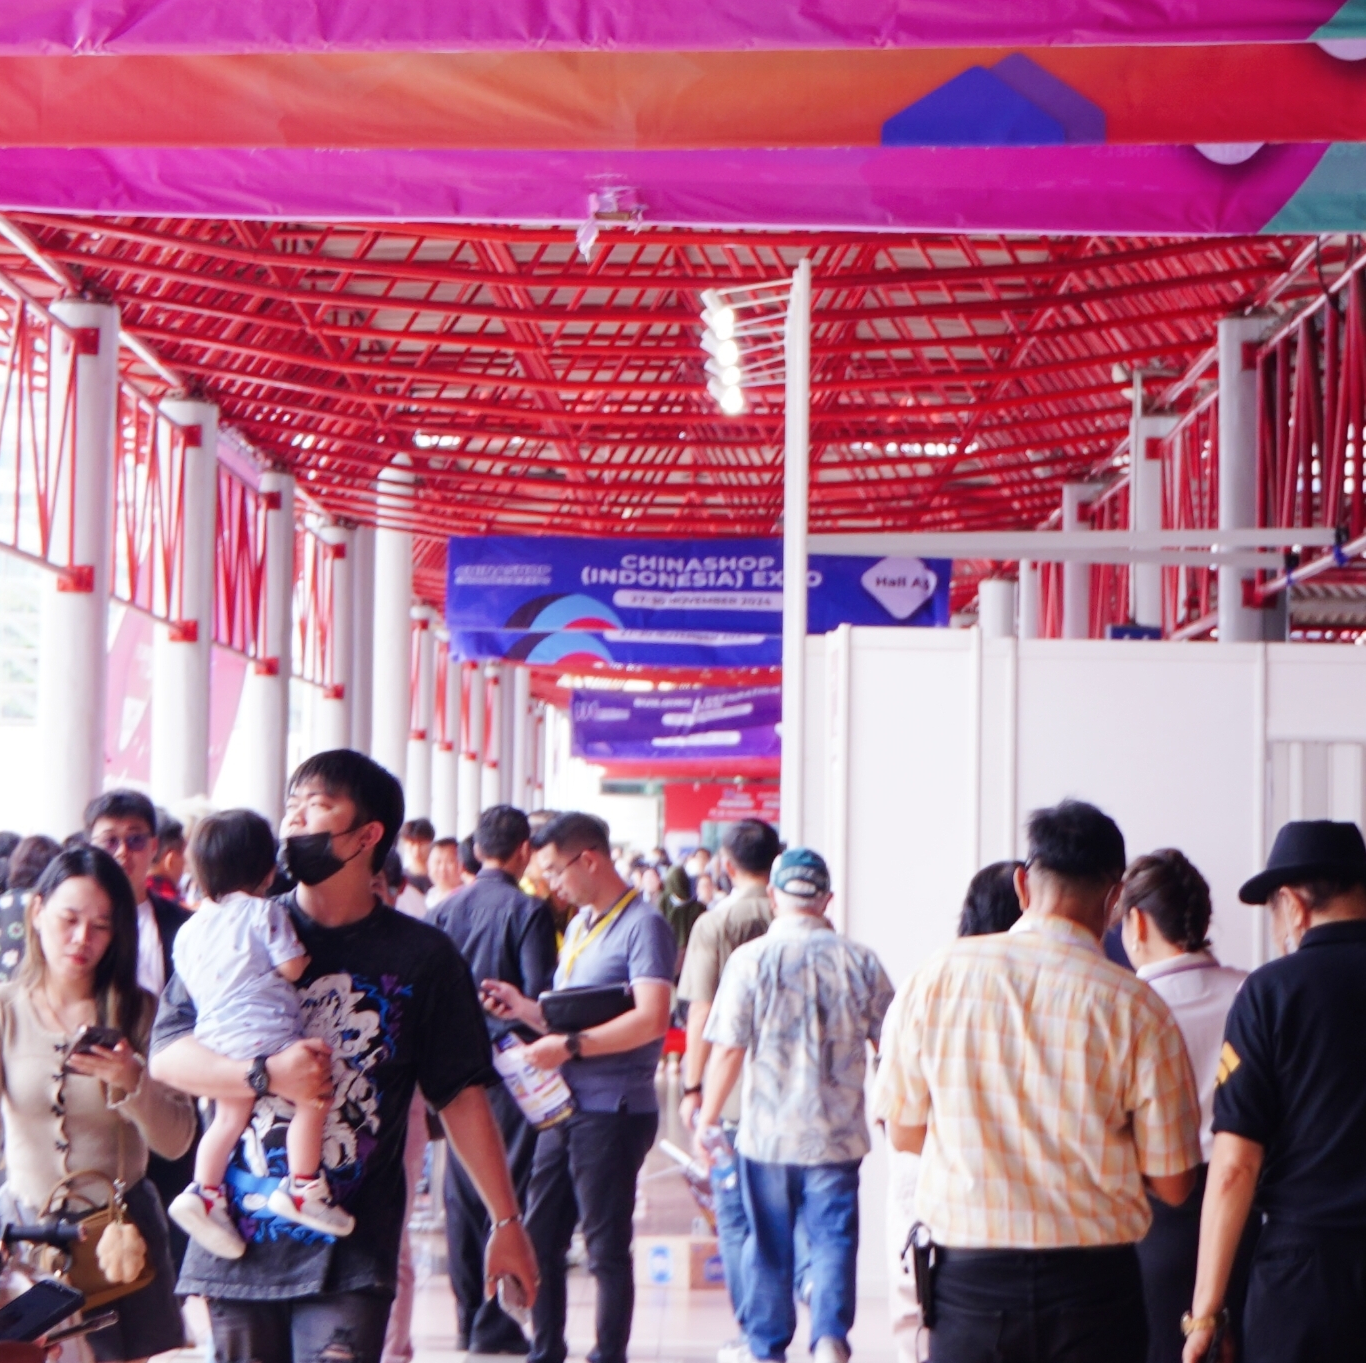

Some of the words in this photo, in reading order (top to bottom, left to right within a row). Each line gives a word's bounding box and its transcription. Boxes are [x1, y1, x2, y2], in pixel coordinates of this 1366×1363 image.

[620, 554, 776, 573] CHINASHOP
[581, 566, 745, 588] (INDONESIA)
[752, 570, 823, 588] EXO
[875, 576, 907, 588] Hall
